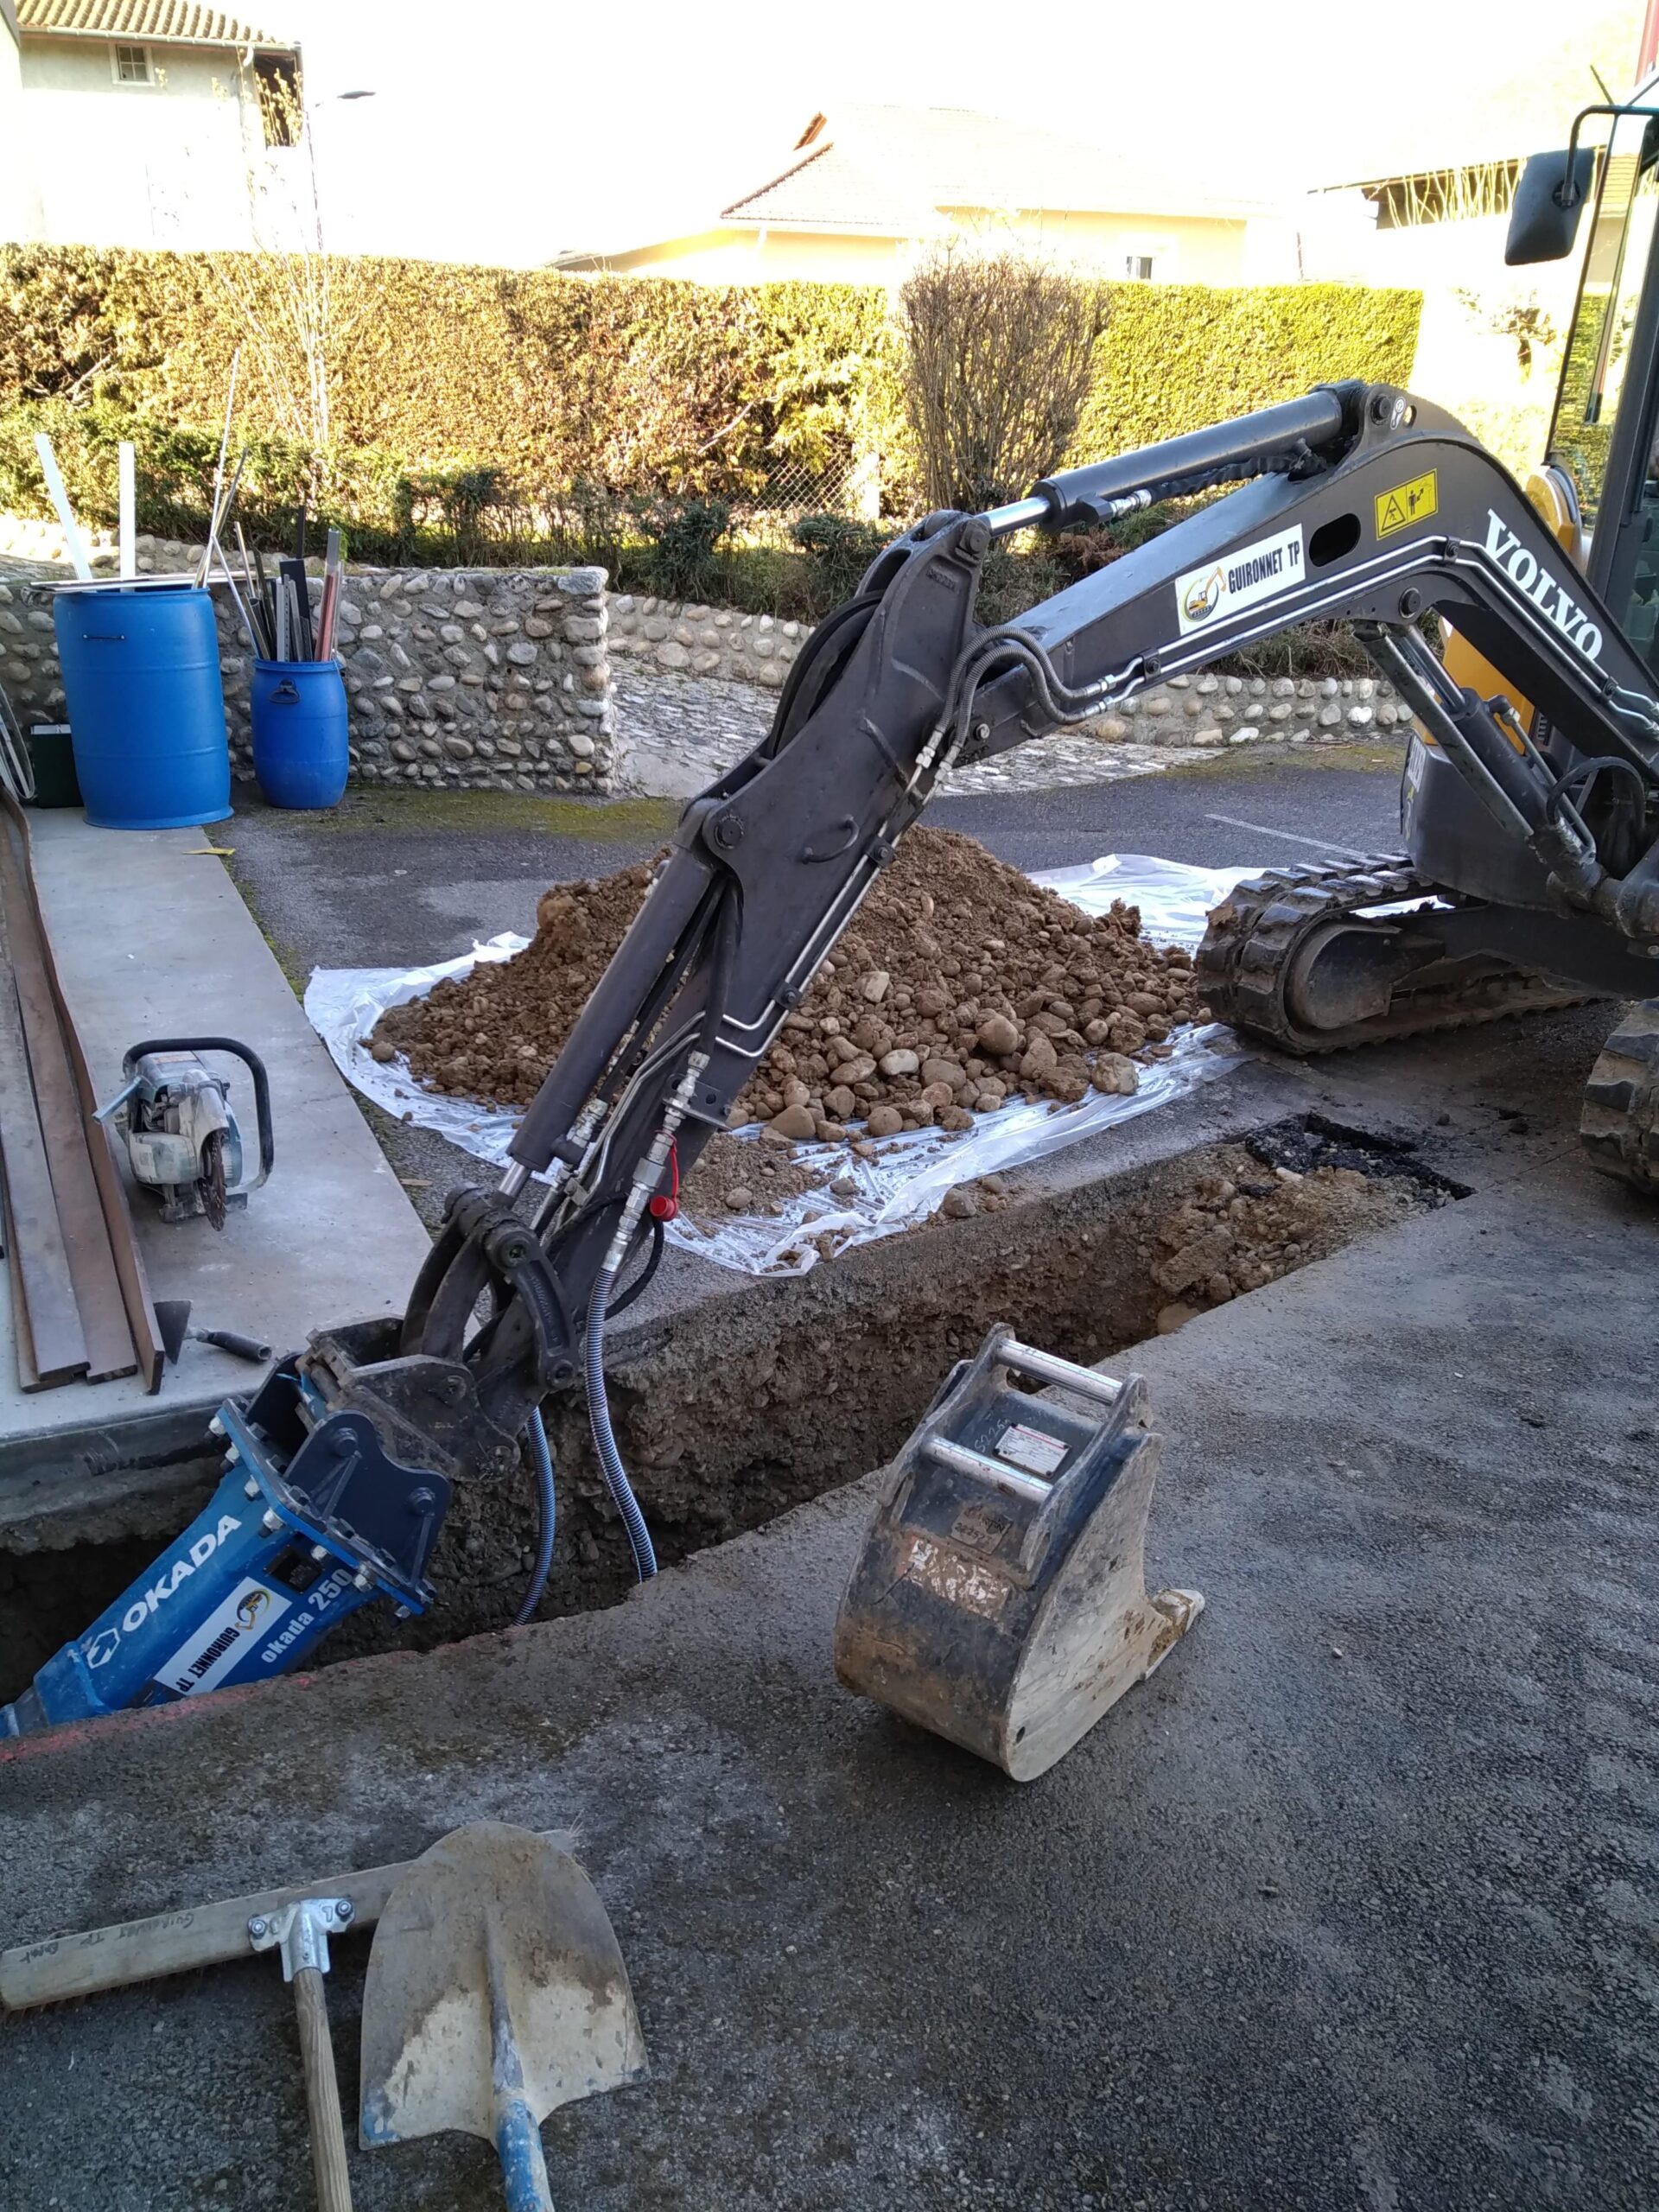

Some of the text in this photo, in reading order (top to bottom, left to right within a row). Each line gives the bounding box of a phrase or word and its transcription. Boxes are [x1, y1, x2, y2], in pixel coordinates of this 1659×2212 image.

[1228, 540, 1300, 594] GUIRONNET TP
[1486, 508, 1603, 661] VOLVO
[123, 1514, 242, 1632] OKADA
[261, 1611, 315, 1663] okada
[308, 1568, 353, 1611] 250
[175, 1626, 240, 1692] GUIRONNET TP
